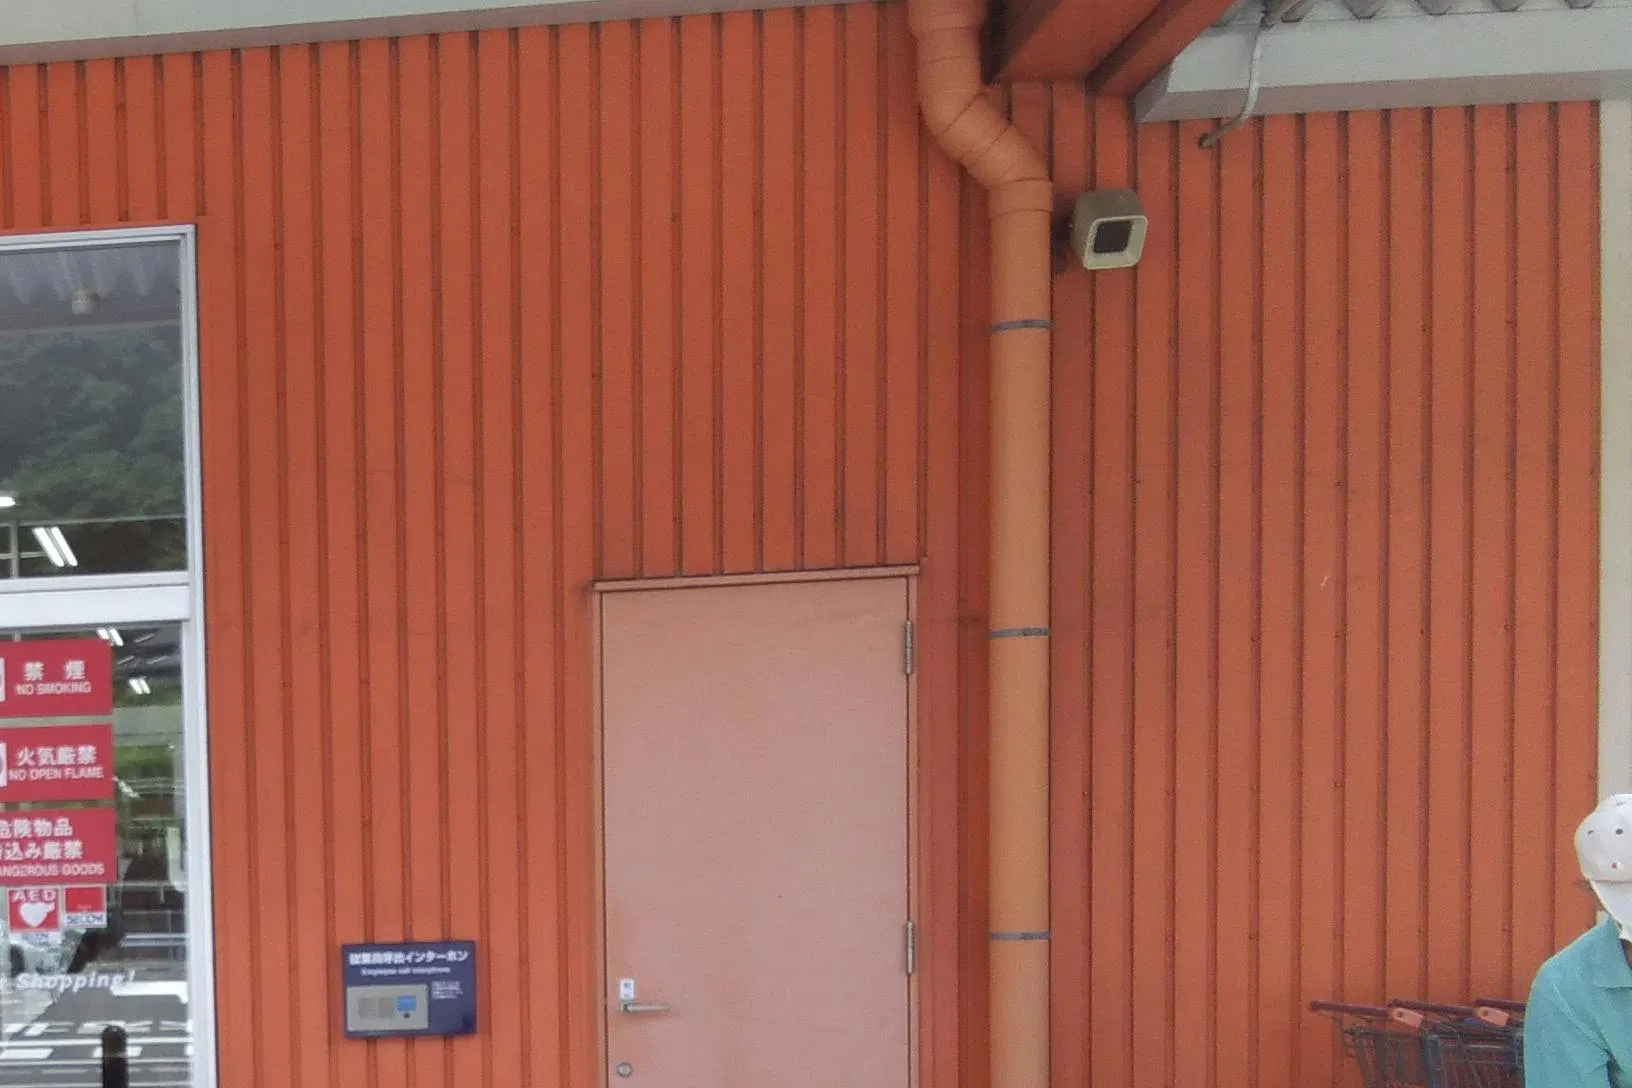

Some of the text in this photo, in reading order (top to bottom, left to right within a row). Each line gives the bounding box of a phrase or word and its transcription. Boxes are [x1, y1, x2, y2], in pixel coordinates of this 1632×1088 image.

[23, 660, 85, 681] 禁煙
[14, 681, 92, 695] NO SMOKING
[16, 745, 97, 766] 火気厳禁
[9, 767, 104, 781] NO OPEN FLAME
[62, 863, 105, 876] GOODS
[12, 888, 58, 902] AED
